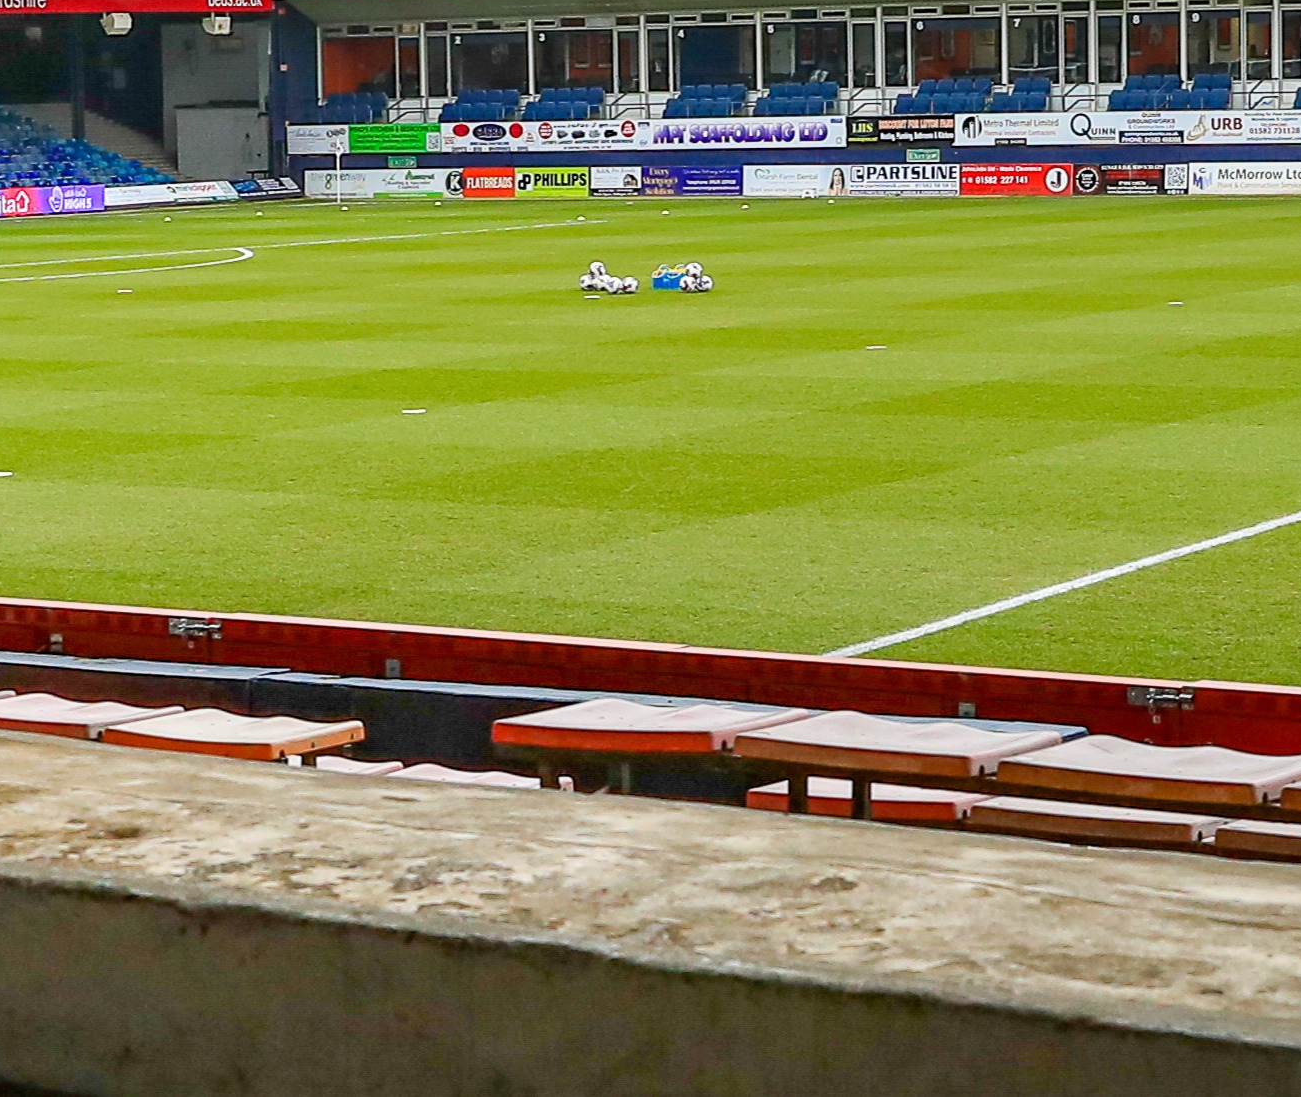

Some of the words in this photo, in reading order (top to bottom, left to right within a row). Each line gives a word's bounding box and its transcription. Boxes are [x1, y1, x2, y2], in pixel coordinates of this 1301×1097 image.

[1070, 113, 1116, 140] QUINN
[1210, 117, 1243, 131] URB
[689, 121, 795, 143] SCAFFOLDING
[798, 121, 828, 141] LTD
[533, 172, 587, 187] PHILLIPS
[866, 166, 957, 180] PARTSLINE
[1217, 168, 1284, 180] McMorrow
[466, 176, 513, 189] FLATBREADS
[975, 176, 997, 185] 01582
[1000, 176, 1014, 184] 227
[64, 198, 86, 210] HIGH
[86, 197, 92, 209] 5
